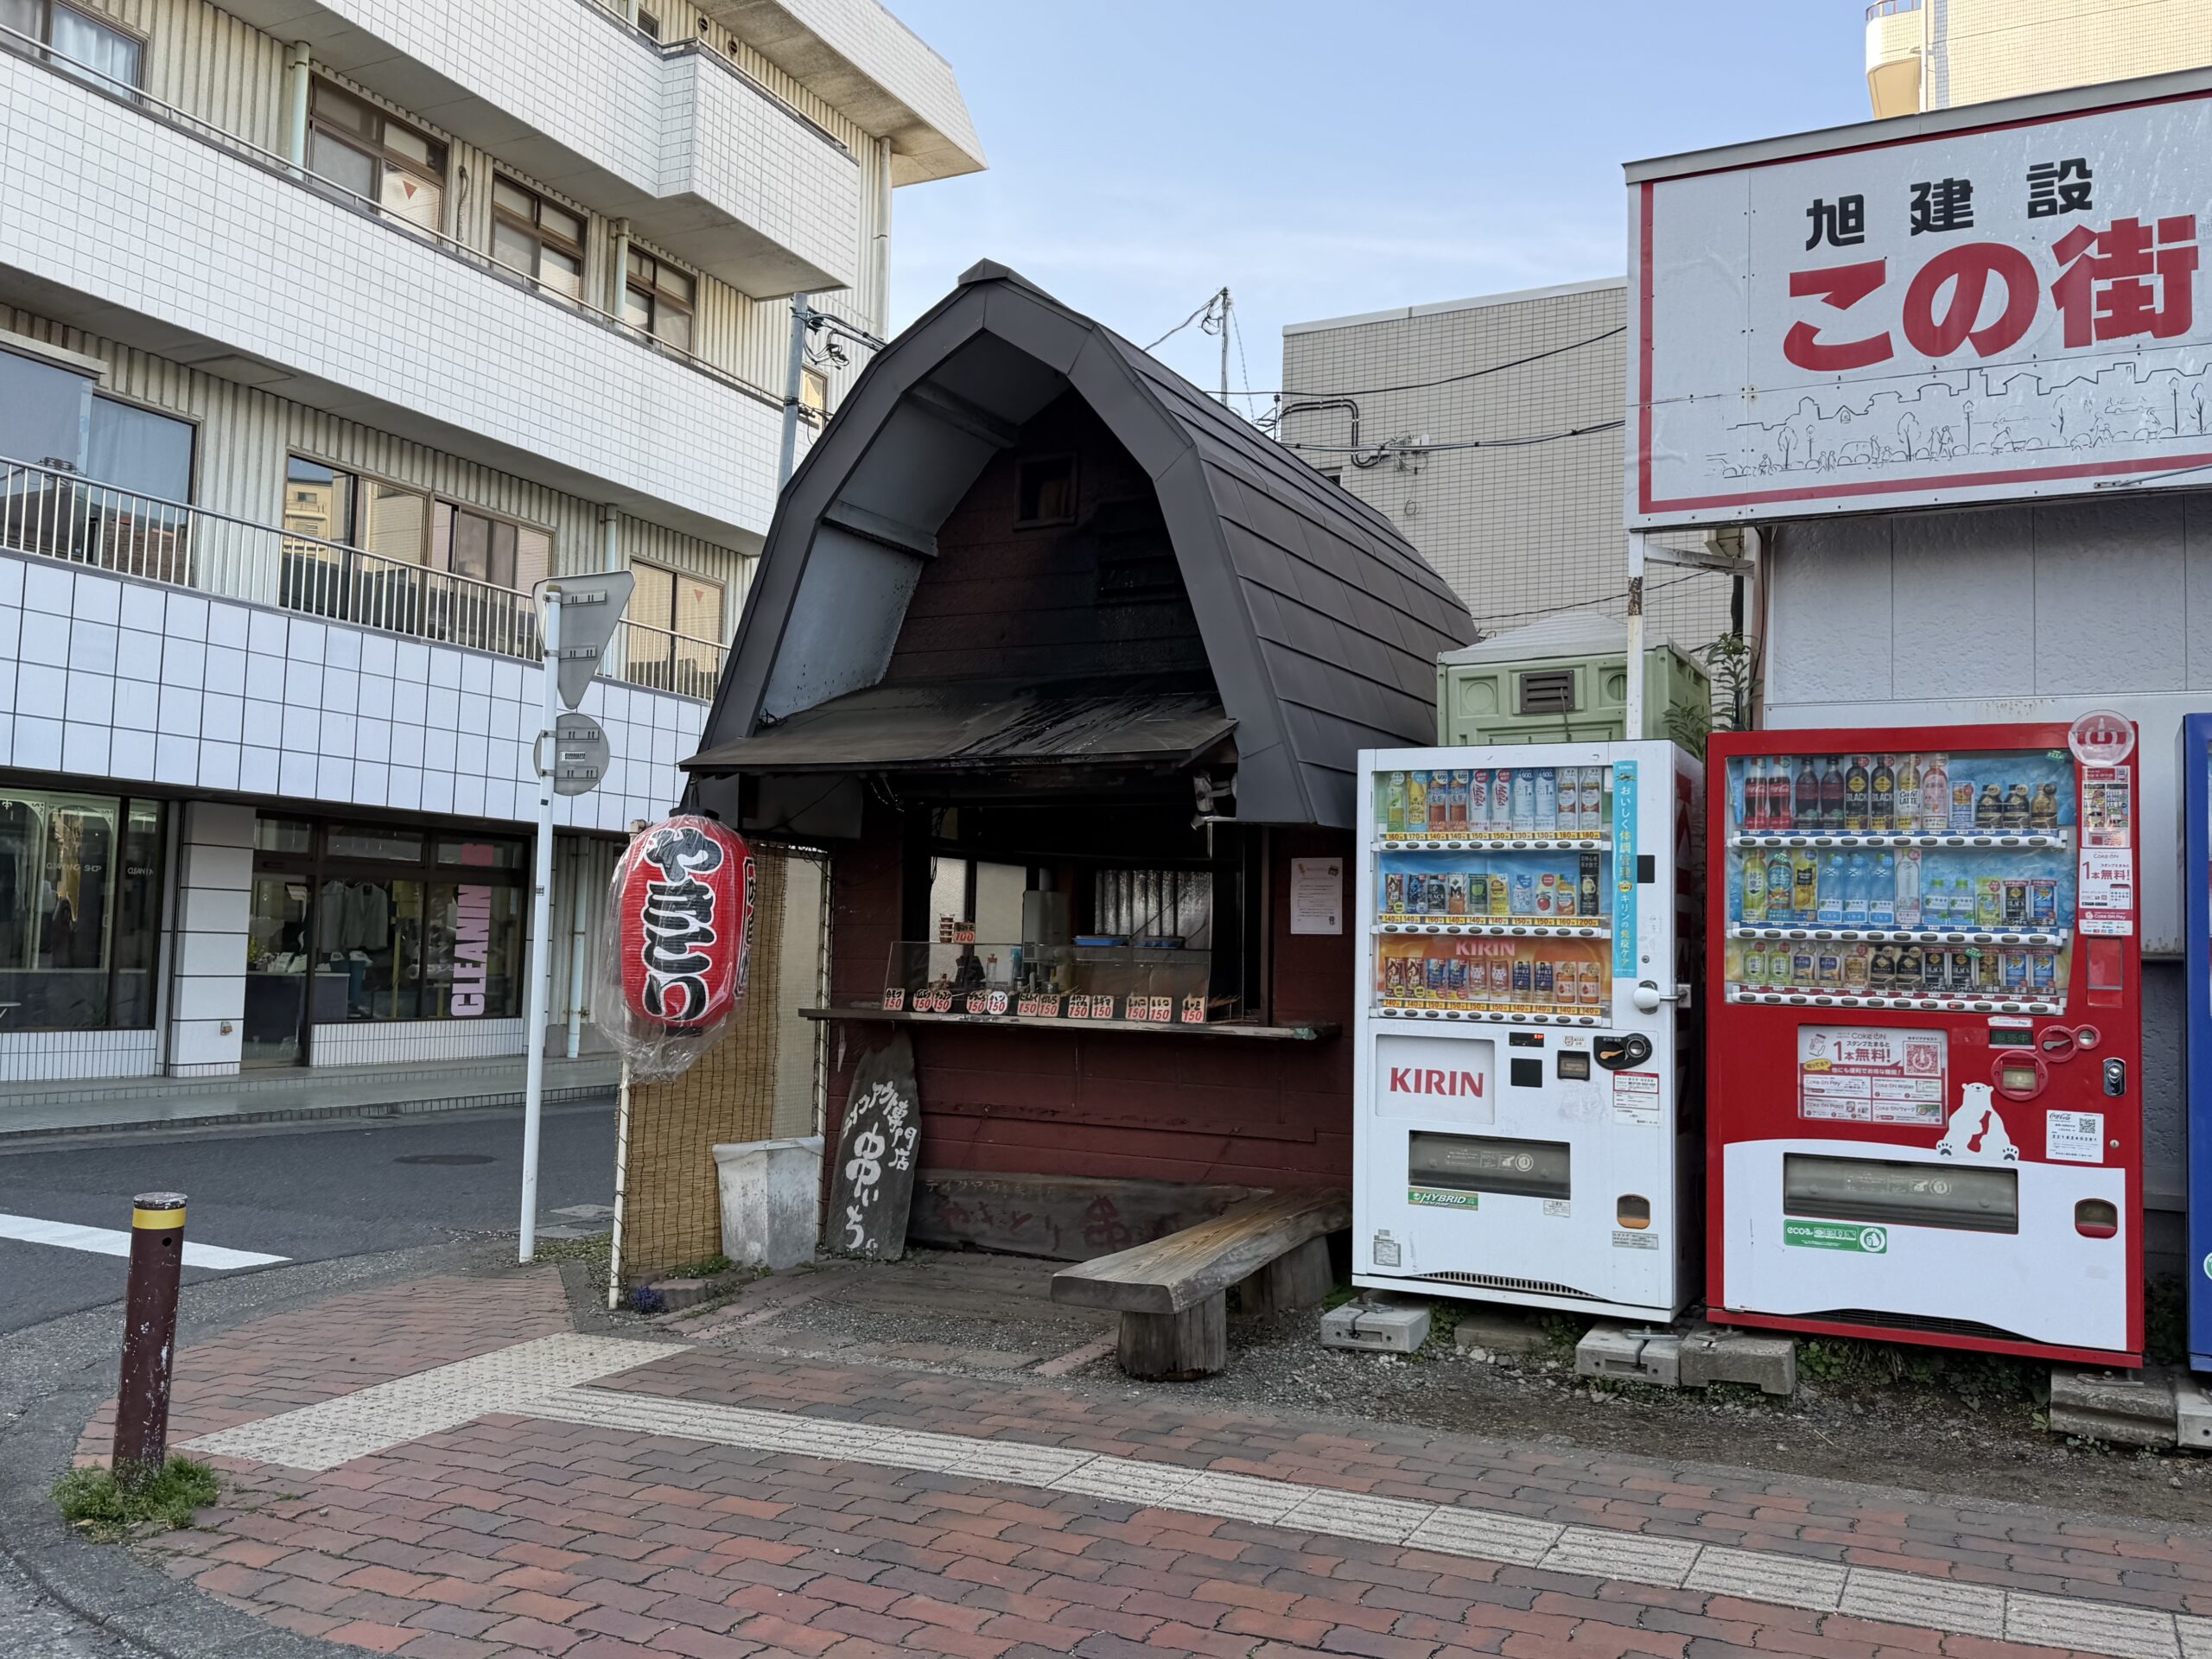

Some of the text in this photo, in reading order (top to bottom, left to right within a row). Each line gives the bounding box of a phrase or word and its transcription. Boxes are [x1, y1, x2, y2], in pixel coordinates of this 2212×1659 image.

[1806, 157, 2093, 251] 旭建設
[1783, 214, 2198, 372] この街
[1846, 793, 1868, 802] BLACK
[1871, 793, 1894, 802] BLACK
[640, 827, 724, 1022] やきとり
[956, 932, 974, 941] 100
[1455, 939, 1516, 957] KIRIN
[885, 999, 901, 1008] 150
[915, 999, 931, 1008] 150
[934, 1000, 950, 1009] 150
[969, 1001, 984, 1011] 150
[988, 1001, 1005, 1011] 150
[1020, 1003, 1037, 1013] 150
[1040, 1005, 1058, 1015] 150
[1069, 1007, 1087, 1016] 150
[1094, 1007, 1111, 1017] 150
[1127, 1008, 1146, 1018] 150
[1151, 1009, 1169, 1020] 150
[1183, 1010, 1202, 1021] 150
[1834, 1040, 1891, 1063] 1本無料!
[1389, 1067, 1484, 1098] KIRIN
[1421, 1192, 1467, 1205] HYBRID
